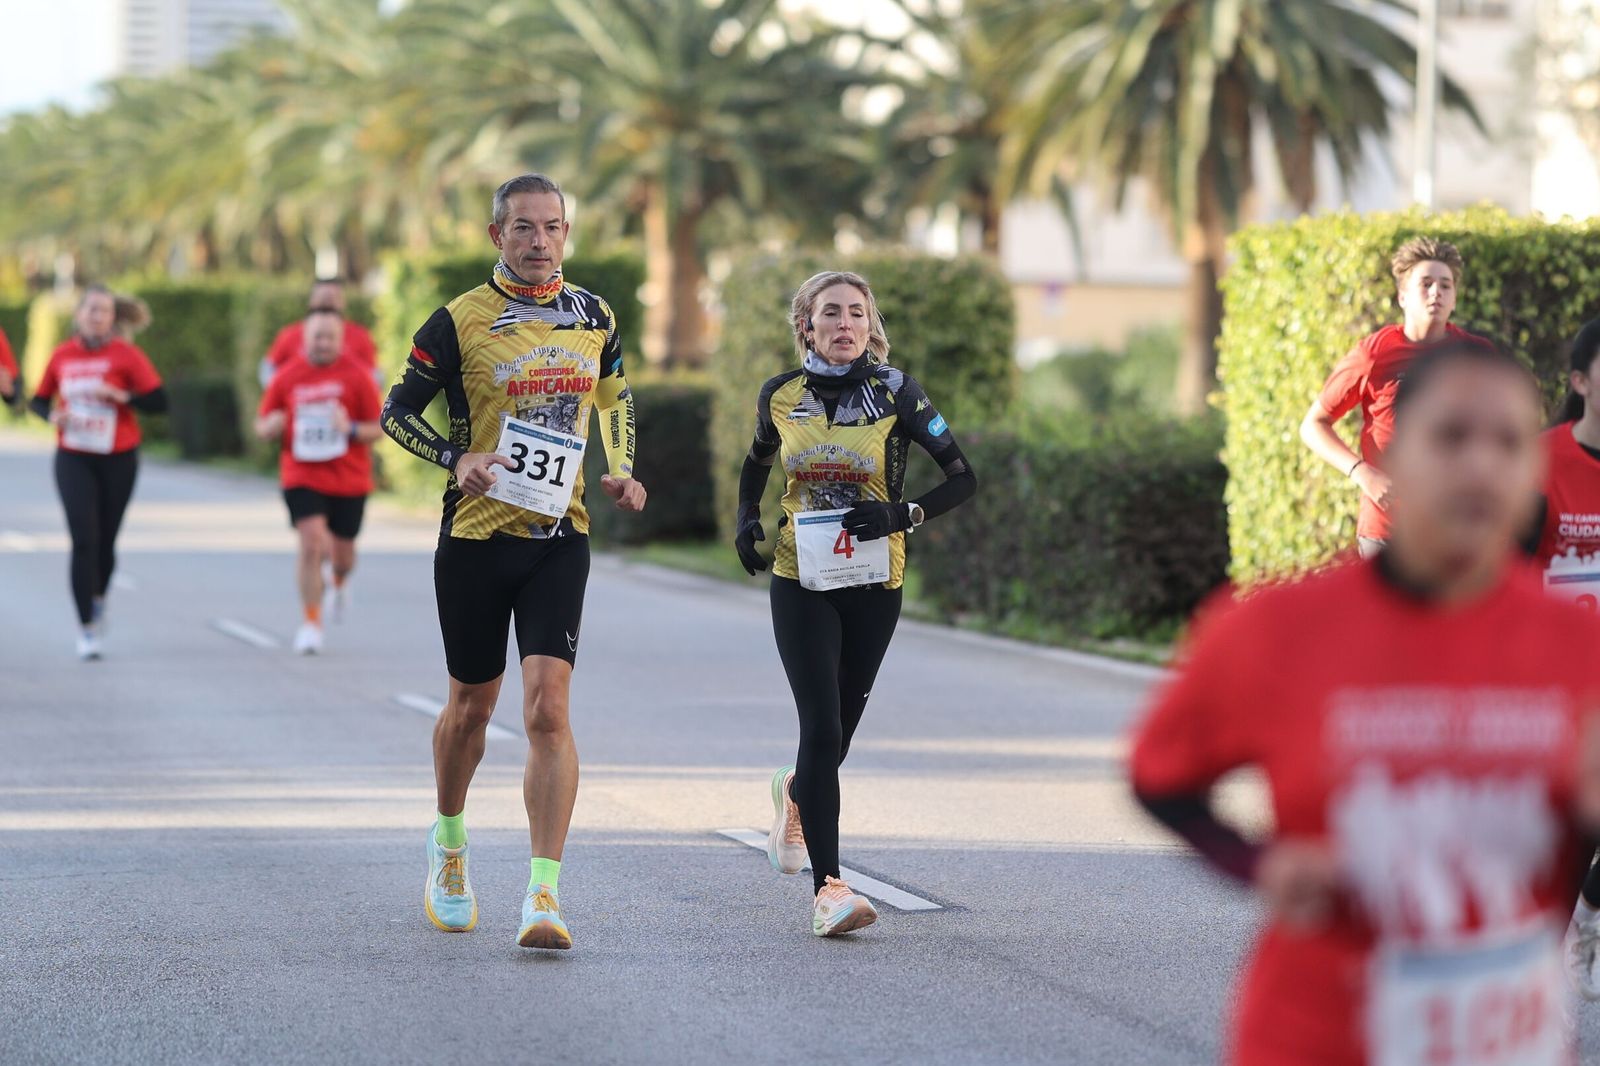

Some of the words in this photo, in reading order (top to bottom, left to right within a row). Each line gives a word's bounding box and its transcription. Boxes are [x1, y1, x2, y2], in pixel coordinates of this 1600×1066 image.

[507, 376, 593, 396] AFRICANUS
[528, 367, 575, 377] CORREDORES
[385, 416, 438, 462] AFRICANUS
[404, 413, 437, 441] CORREDORES
[610, 409, 620, 449] CORREDORES
[625, 399, 635, 462] AFRICANUS
[504, 442, 567, 488] 331
[795, 471, 870, 483] AFRICANUS
[833, 530, 855, 559] 4
